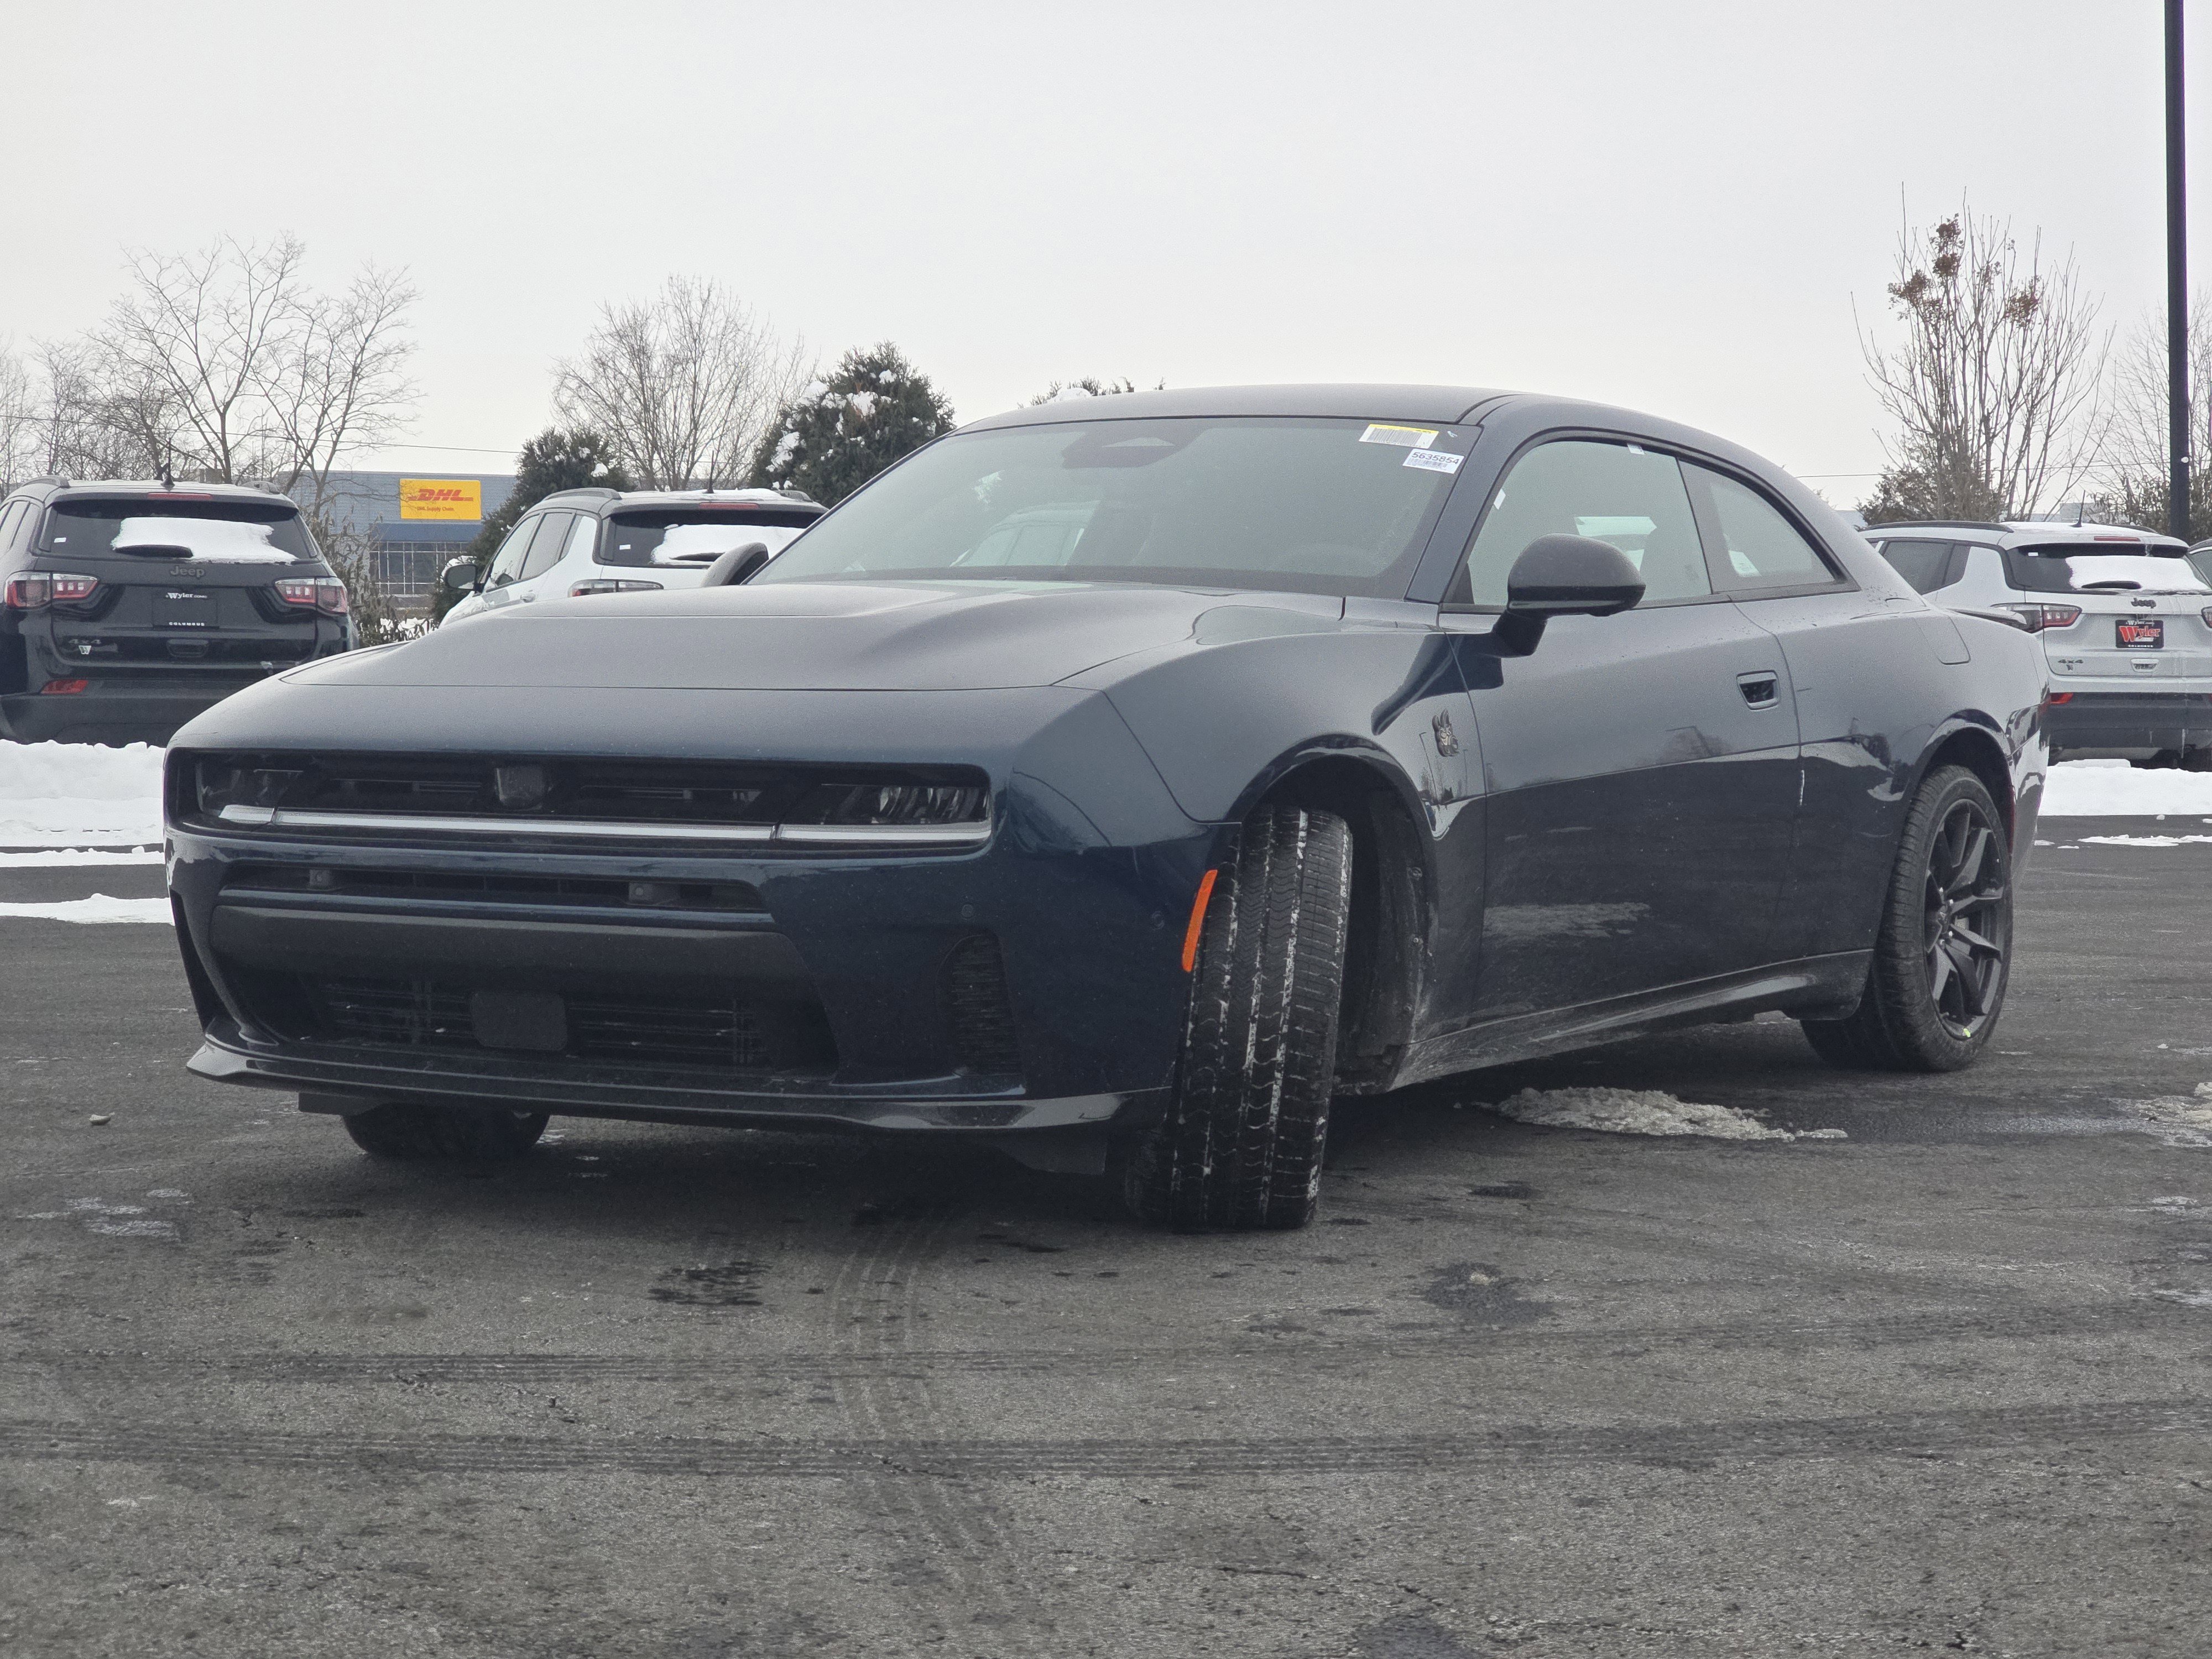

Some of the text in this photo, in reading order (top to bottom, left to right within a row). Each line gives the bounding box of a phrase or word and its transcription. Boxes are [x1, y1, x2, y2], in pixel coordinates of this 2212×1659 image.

[1411, 452, 1459, 465] 5635854
[415, 488, 466, 502] DHL
[170, 566, 205, 578] Jeep
[2130, 597, 2156, 609] Jeep
[2119, 625, 2161, 642] Wyler
